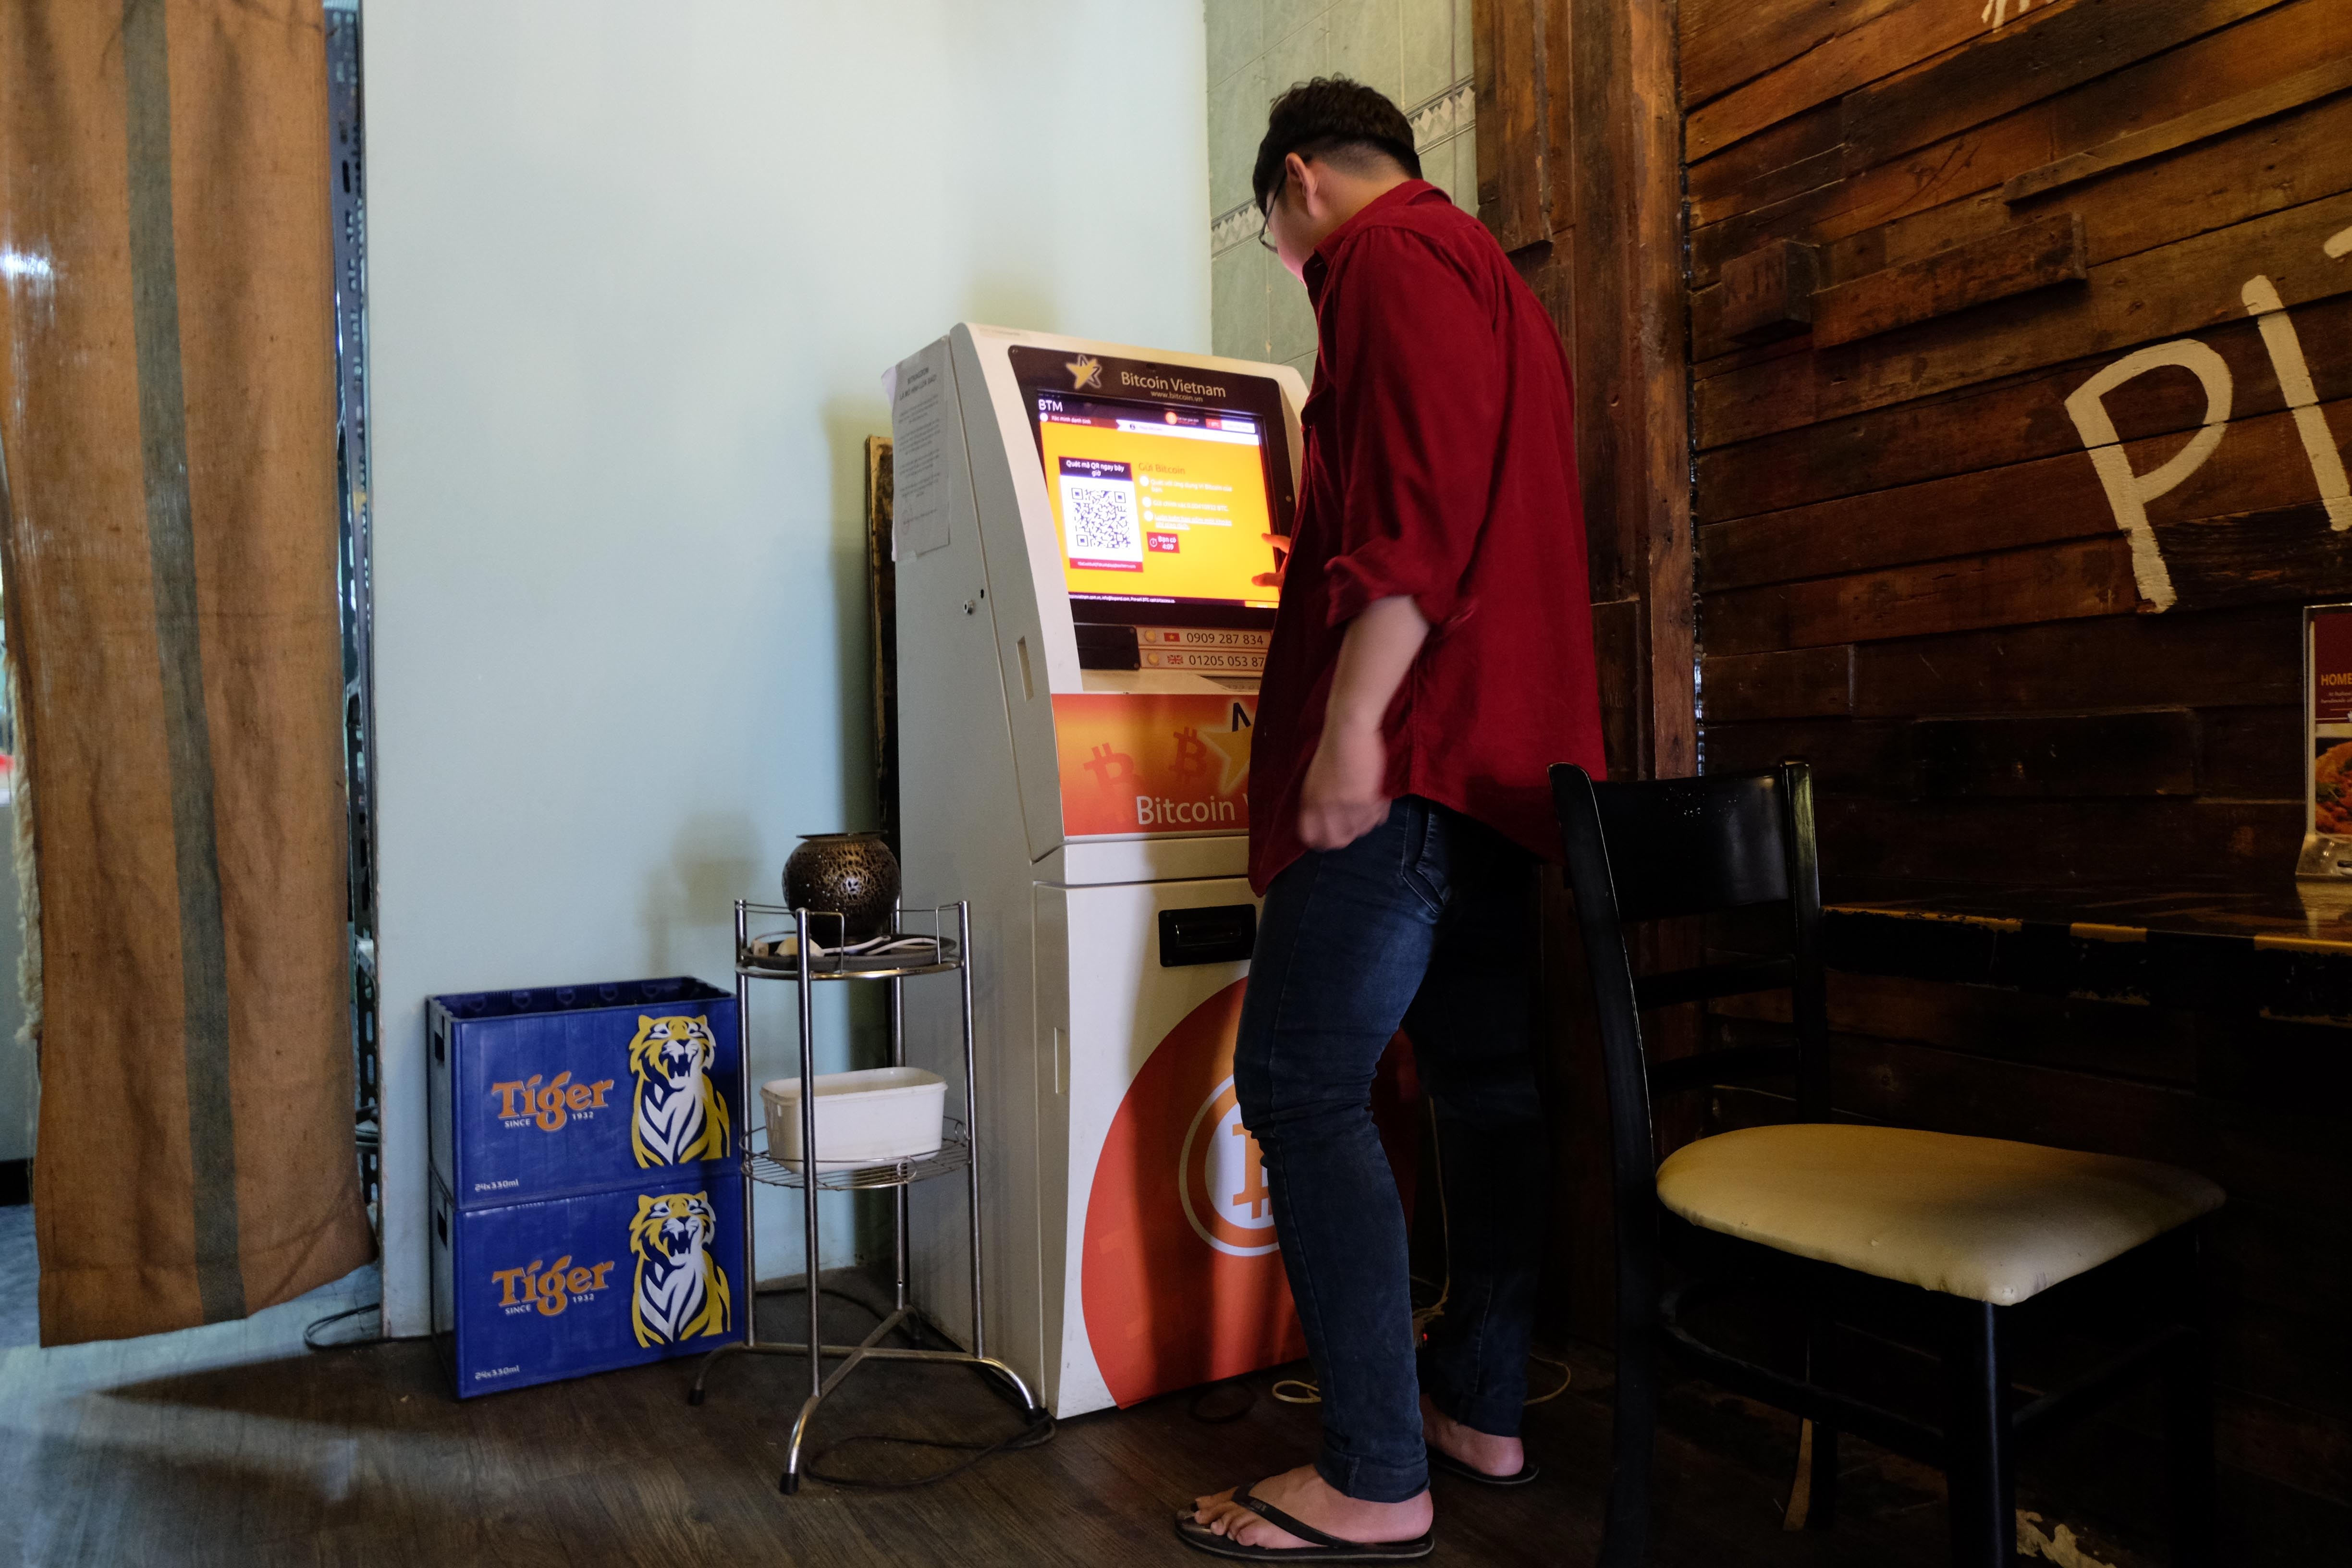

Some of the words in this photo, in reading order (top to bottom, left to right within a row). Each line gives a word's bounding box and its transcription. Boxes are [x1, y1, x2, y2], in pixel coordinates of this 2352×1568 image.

[1121, 371, 1168, 391] Bitcoin
[1171, 378, 1226, 398] Vietnam
[1151, 391, 1203, 403] www.bitcoin.vn
[1038, 399, 1063, 412] BTM
[2064, 226, 2352, 614] PI
[1155, 464, 1185, 475] Bitcoin
[1187, 632, 1215, 644] 0909
[1219, 633, 1239, 645] 287
[1243, 634, 1263, 645] 834
[1189, 654, 1224, 667] 01205
[1228, 656, 1248, 667] 053
[1136, 795, 1235, 825] Bitcoin
[491, 1070, 614, 1132] Tiger
[504, 1118, 531, 1128] SINCE
[572, 1111, 594, 1121] 1932
[474, 1178, 519, 1192] 24x330ml
[492, 1255, 614, 1317] Tiger
[505, 1304, 531, 1315] SINCE
[573, 1294, 595, 1304] 1932
[474, 1365, 520, 1381] 24x330ml
